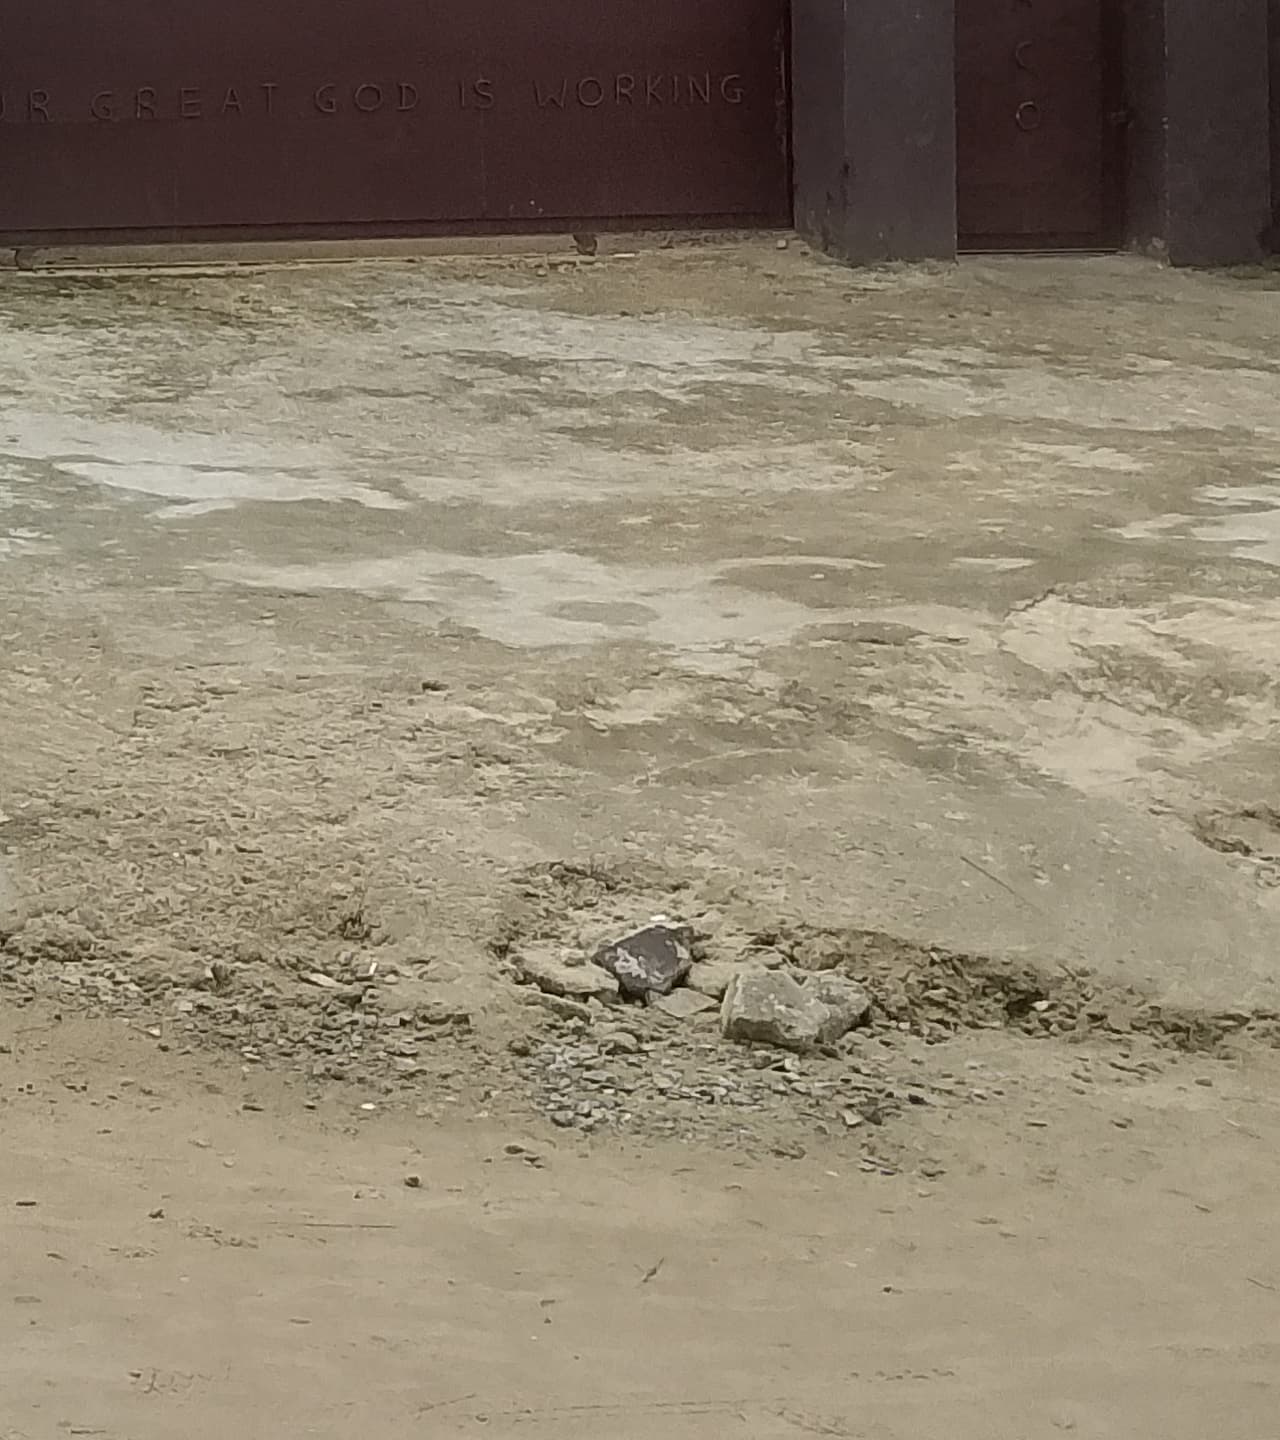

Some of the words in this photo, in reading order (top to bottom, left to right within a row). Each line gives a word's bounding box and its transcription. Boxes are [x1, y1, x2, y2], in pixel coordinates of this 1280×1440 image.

[90, 83, 280, 121] GREAT
[314, 80, 422, 114] GOD
[458, 78, 496, 111] IS
[533, 72, 746, 109] WORKING
